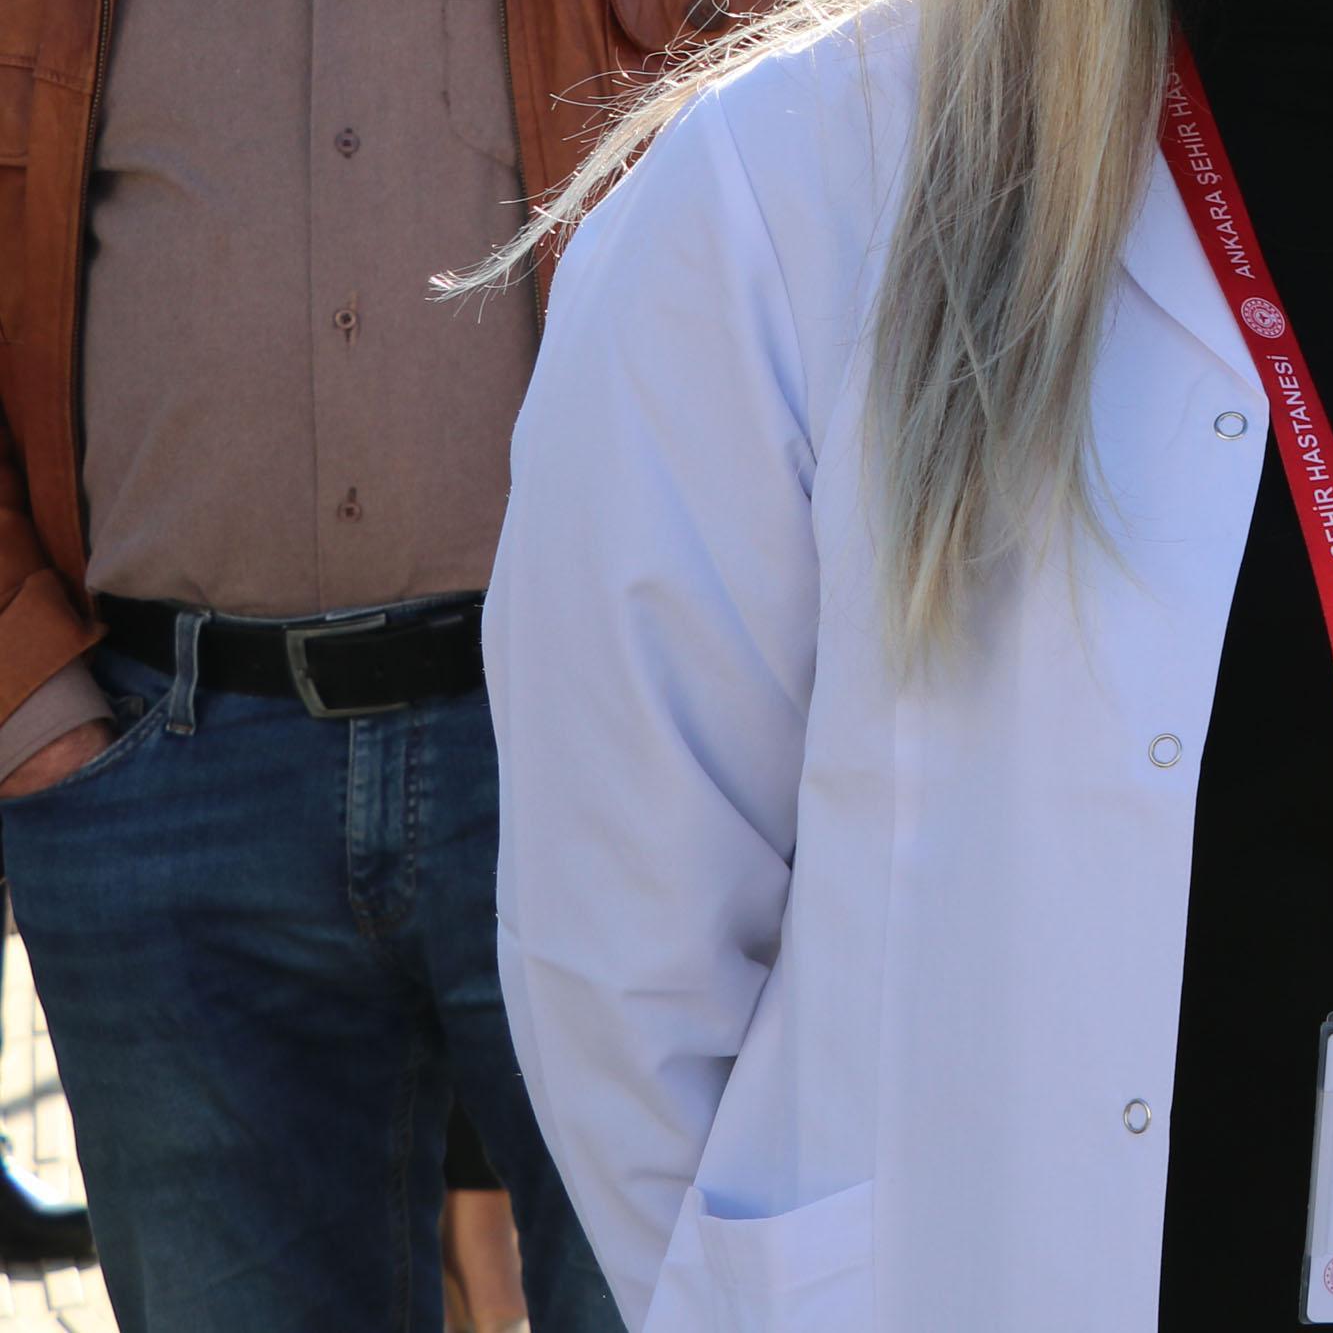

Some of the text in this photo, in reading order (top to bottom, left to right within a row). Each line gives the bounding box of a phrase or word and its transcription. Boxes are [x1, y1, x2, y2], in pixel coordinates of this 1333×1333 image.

[1177, 122, 1223, 185] ŞEHİR
[1204, 190, 1256, 280] ANKARA
[1266, 355, 1330, 482] HASTANESİ
